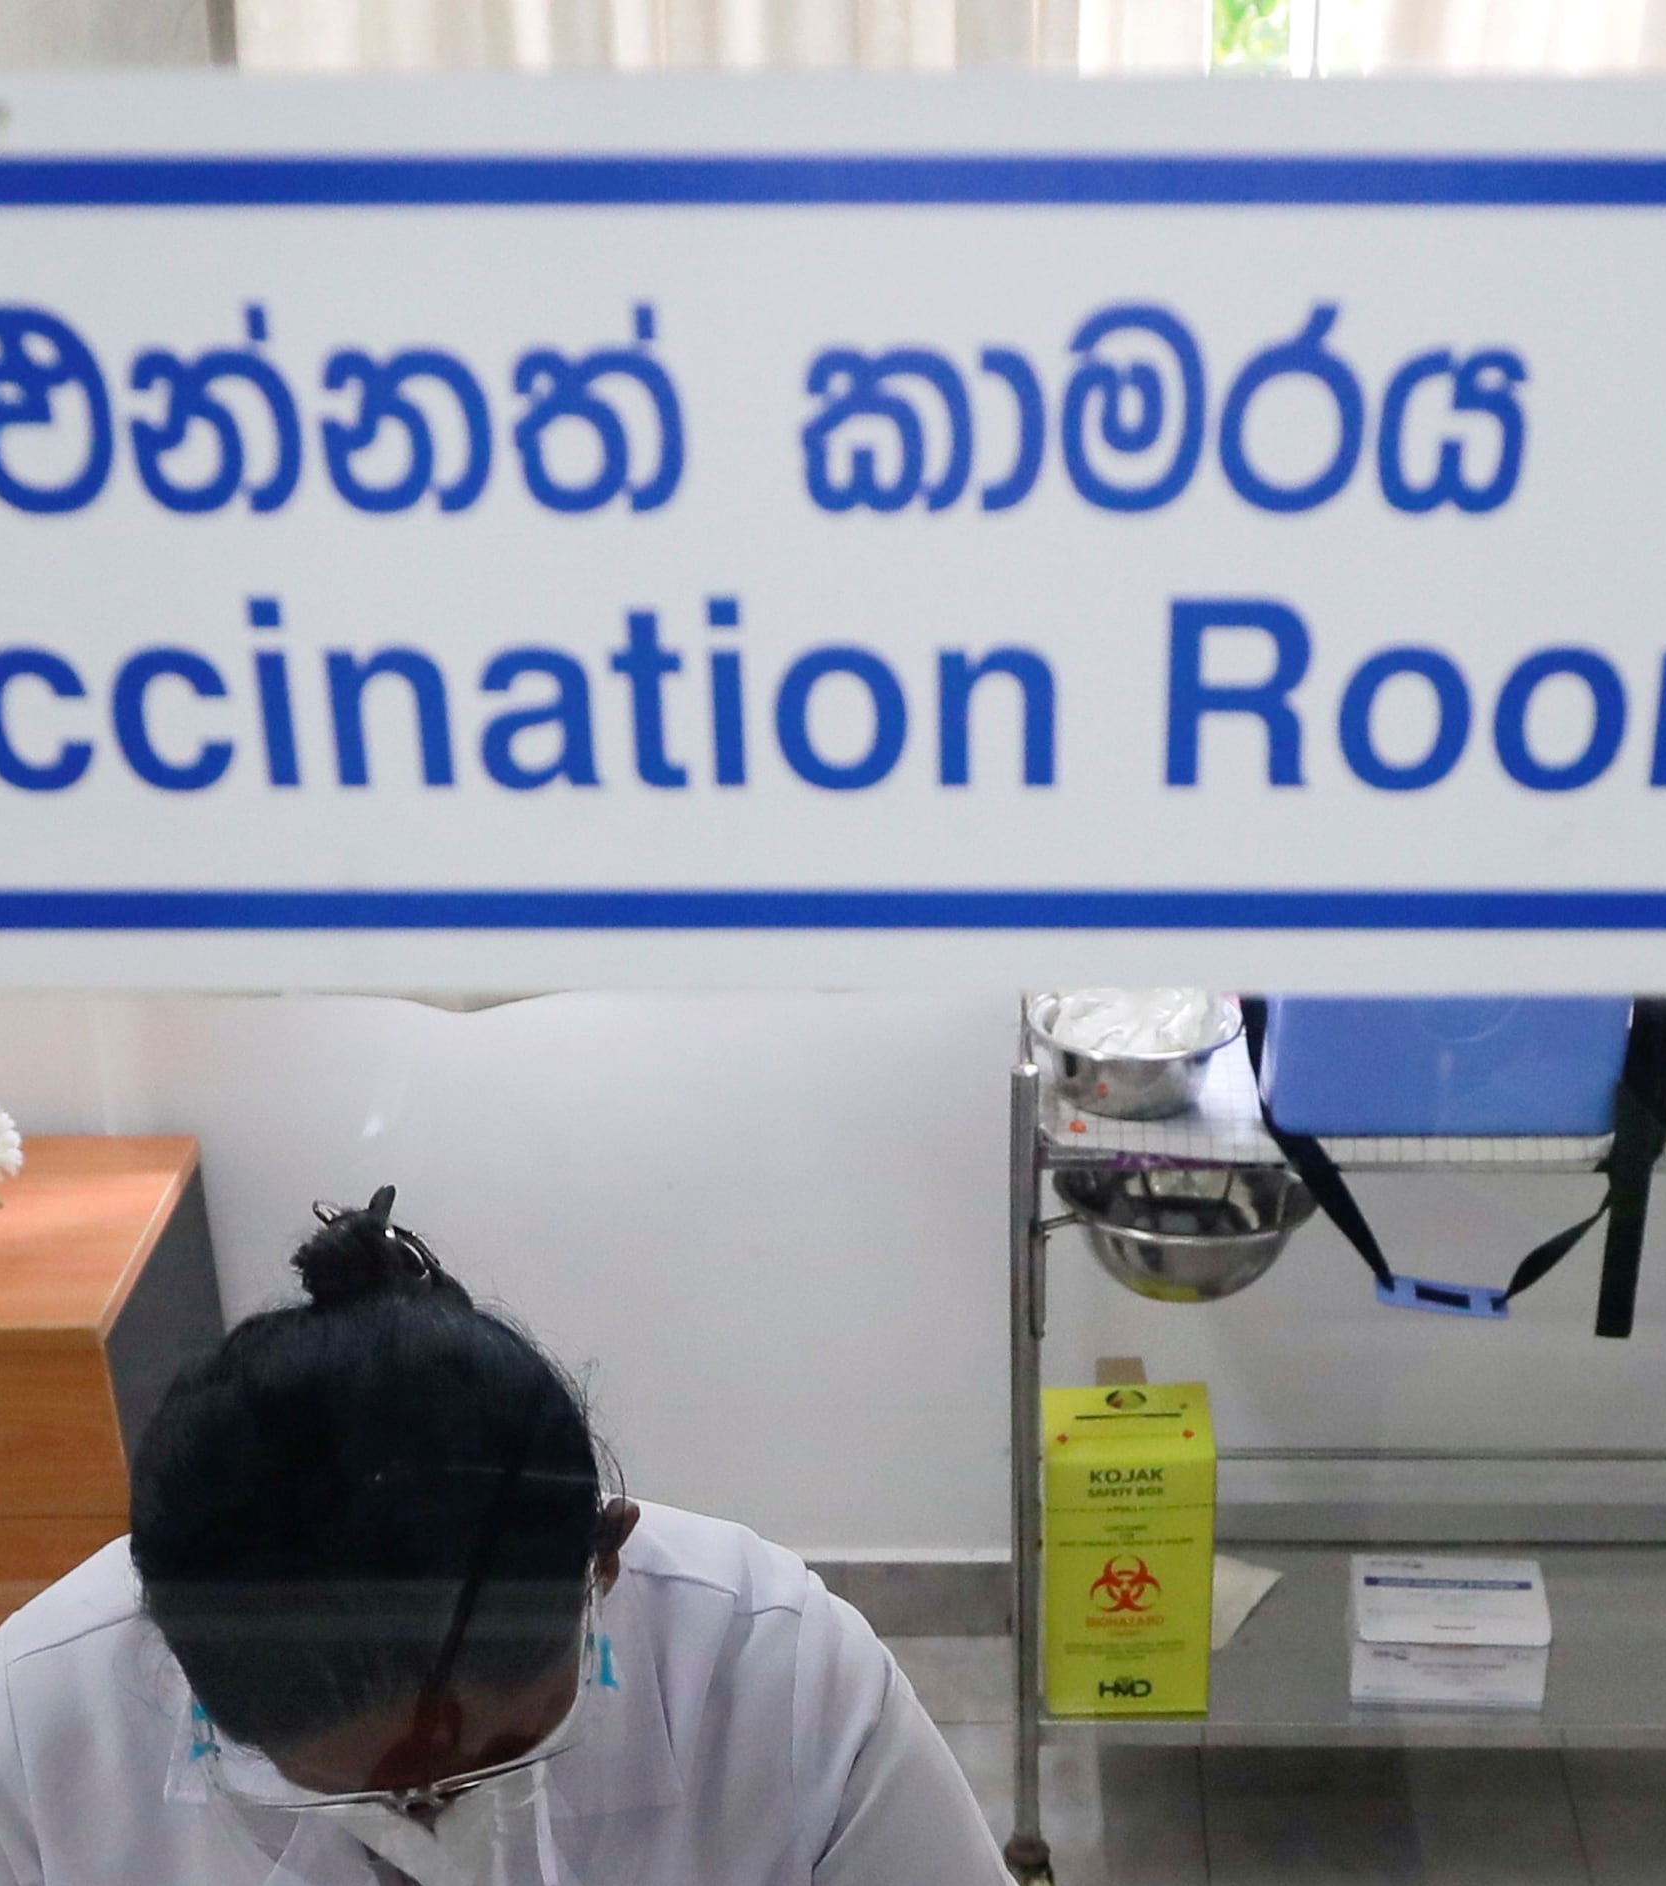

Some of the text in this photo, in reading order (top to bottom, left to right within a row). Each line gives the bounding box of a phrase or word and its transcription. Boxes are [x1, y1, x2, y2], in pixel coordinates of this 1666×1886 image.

[800, 305, 1527, 514] කාමරය
[1089, 1467, 1164, 1483] KOJAK
[1087, 1486, 1164, 1498] SAFETY BOX
[1085, 1615, 1165, 1628] BIOHAZARD
[1098, 1678, 1153, 1699] HMD
